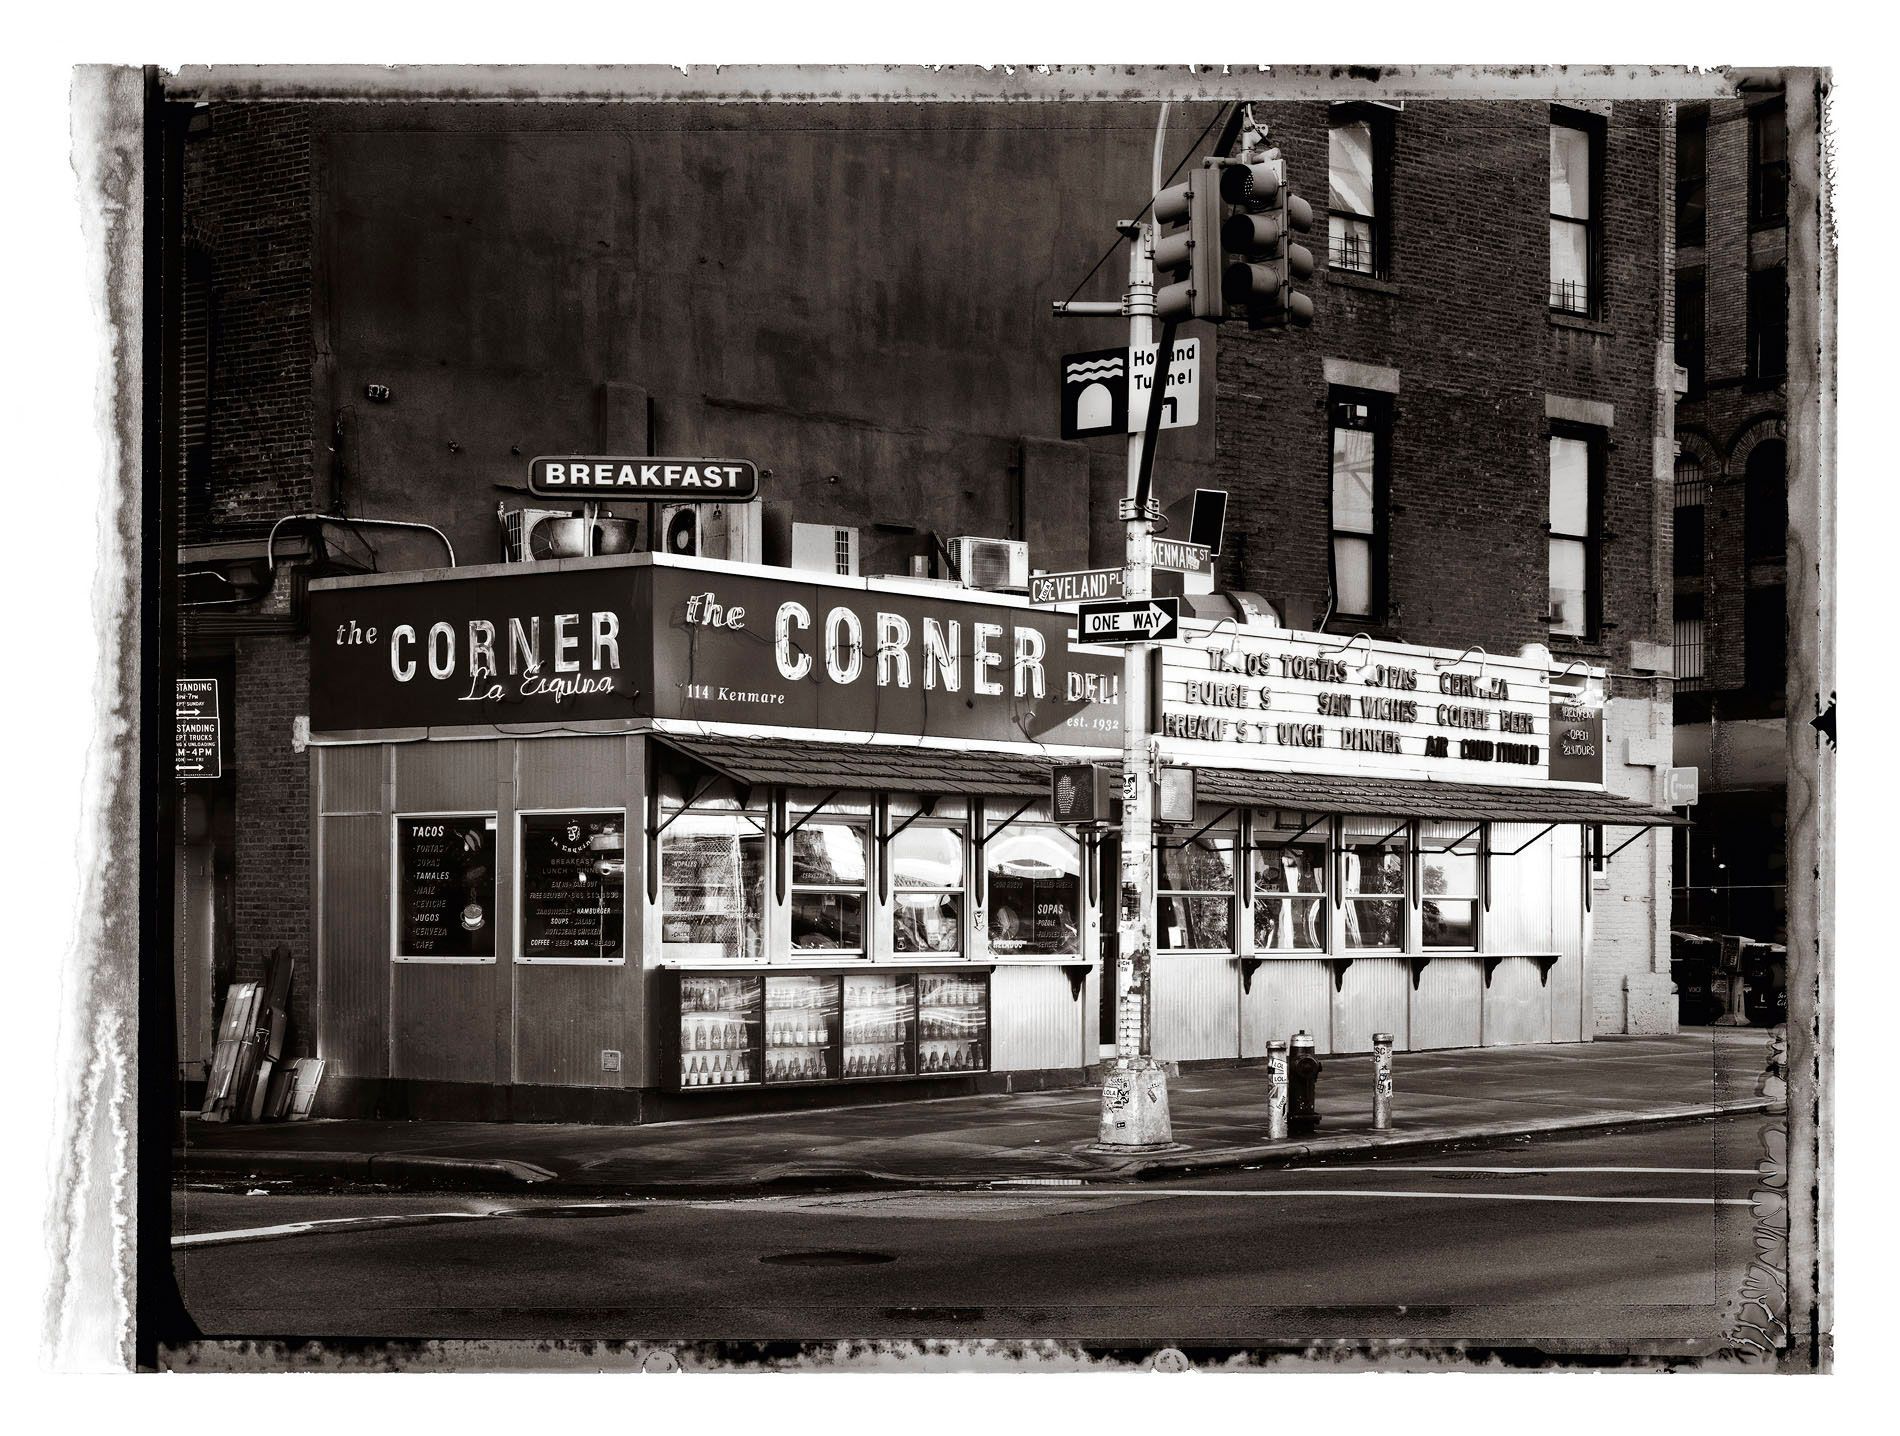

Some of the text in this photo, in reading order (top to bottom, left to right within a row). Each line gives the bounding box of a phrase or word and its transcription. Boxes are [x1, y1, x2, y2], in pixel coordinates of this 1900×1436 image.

[1134, 344, 1195, 367] Hoand
[1134, 369, 1192, 390] Tunel
[545, 463, 742, 488] BREAKFAST
[1199, 548, 1209, 561] ST
[1109, 572, 1122, 585] PL
[1092, 612, 1163, 631] ONE WAY
[336, 611, 620, 682] the CORNER
[686, 592, 1046, 698] the CORNER
[1207, 647, 1271, 677] TOS
[1280, 653, 1349, 683] TORTAS
[1364, 663, 1418, 691] OPAS
[176, 683, 212, 692] STANDING
[458, 660, 614, 704] La Esquina
[1067, 671, 1119, 705] DELI
[686, 684, 786, 704] 114 Kenmare
[1317, 692, 1352, 717] SAN
[1361, 696, 1418, 723] WICHES
[1437, 703, 1490, 730] COFFEE
[1499, 709, 1535, 735] BEER
[176, 724, 215, 733] STANDING
[1066, 717, 1119, 731] est. 1932
[1341, 727, 1403, 754] DINNER
[176, 748, 213, 757] M-4PM
[412, 826, 445, 838] TACOS
[1037, 904, 1064, 915] SOPAS
